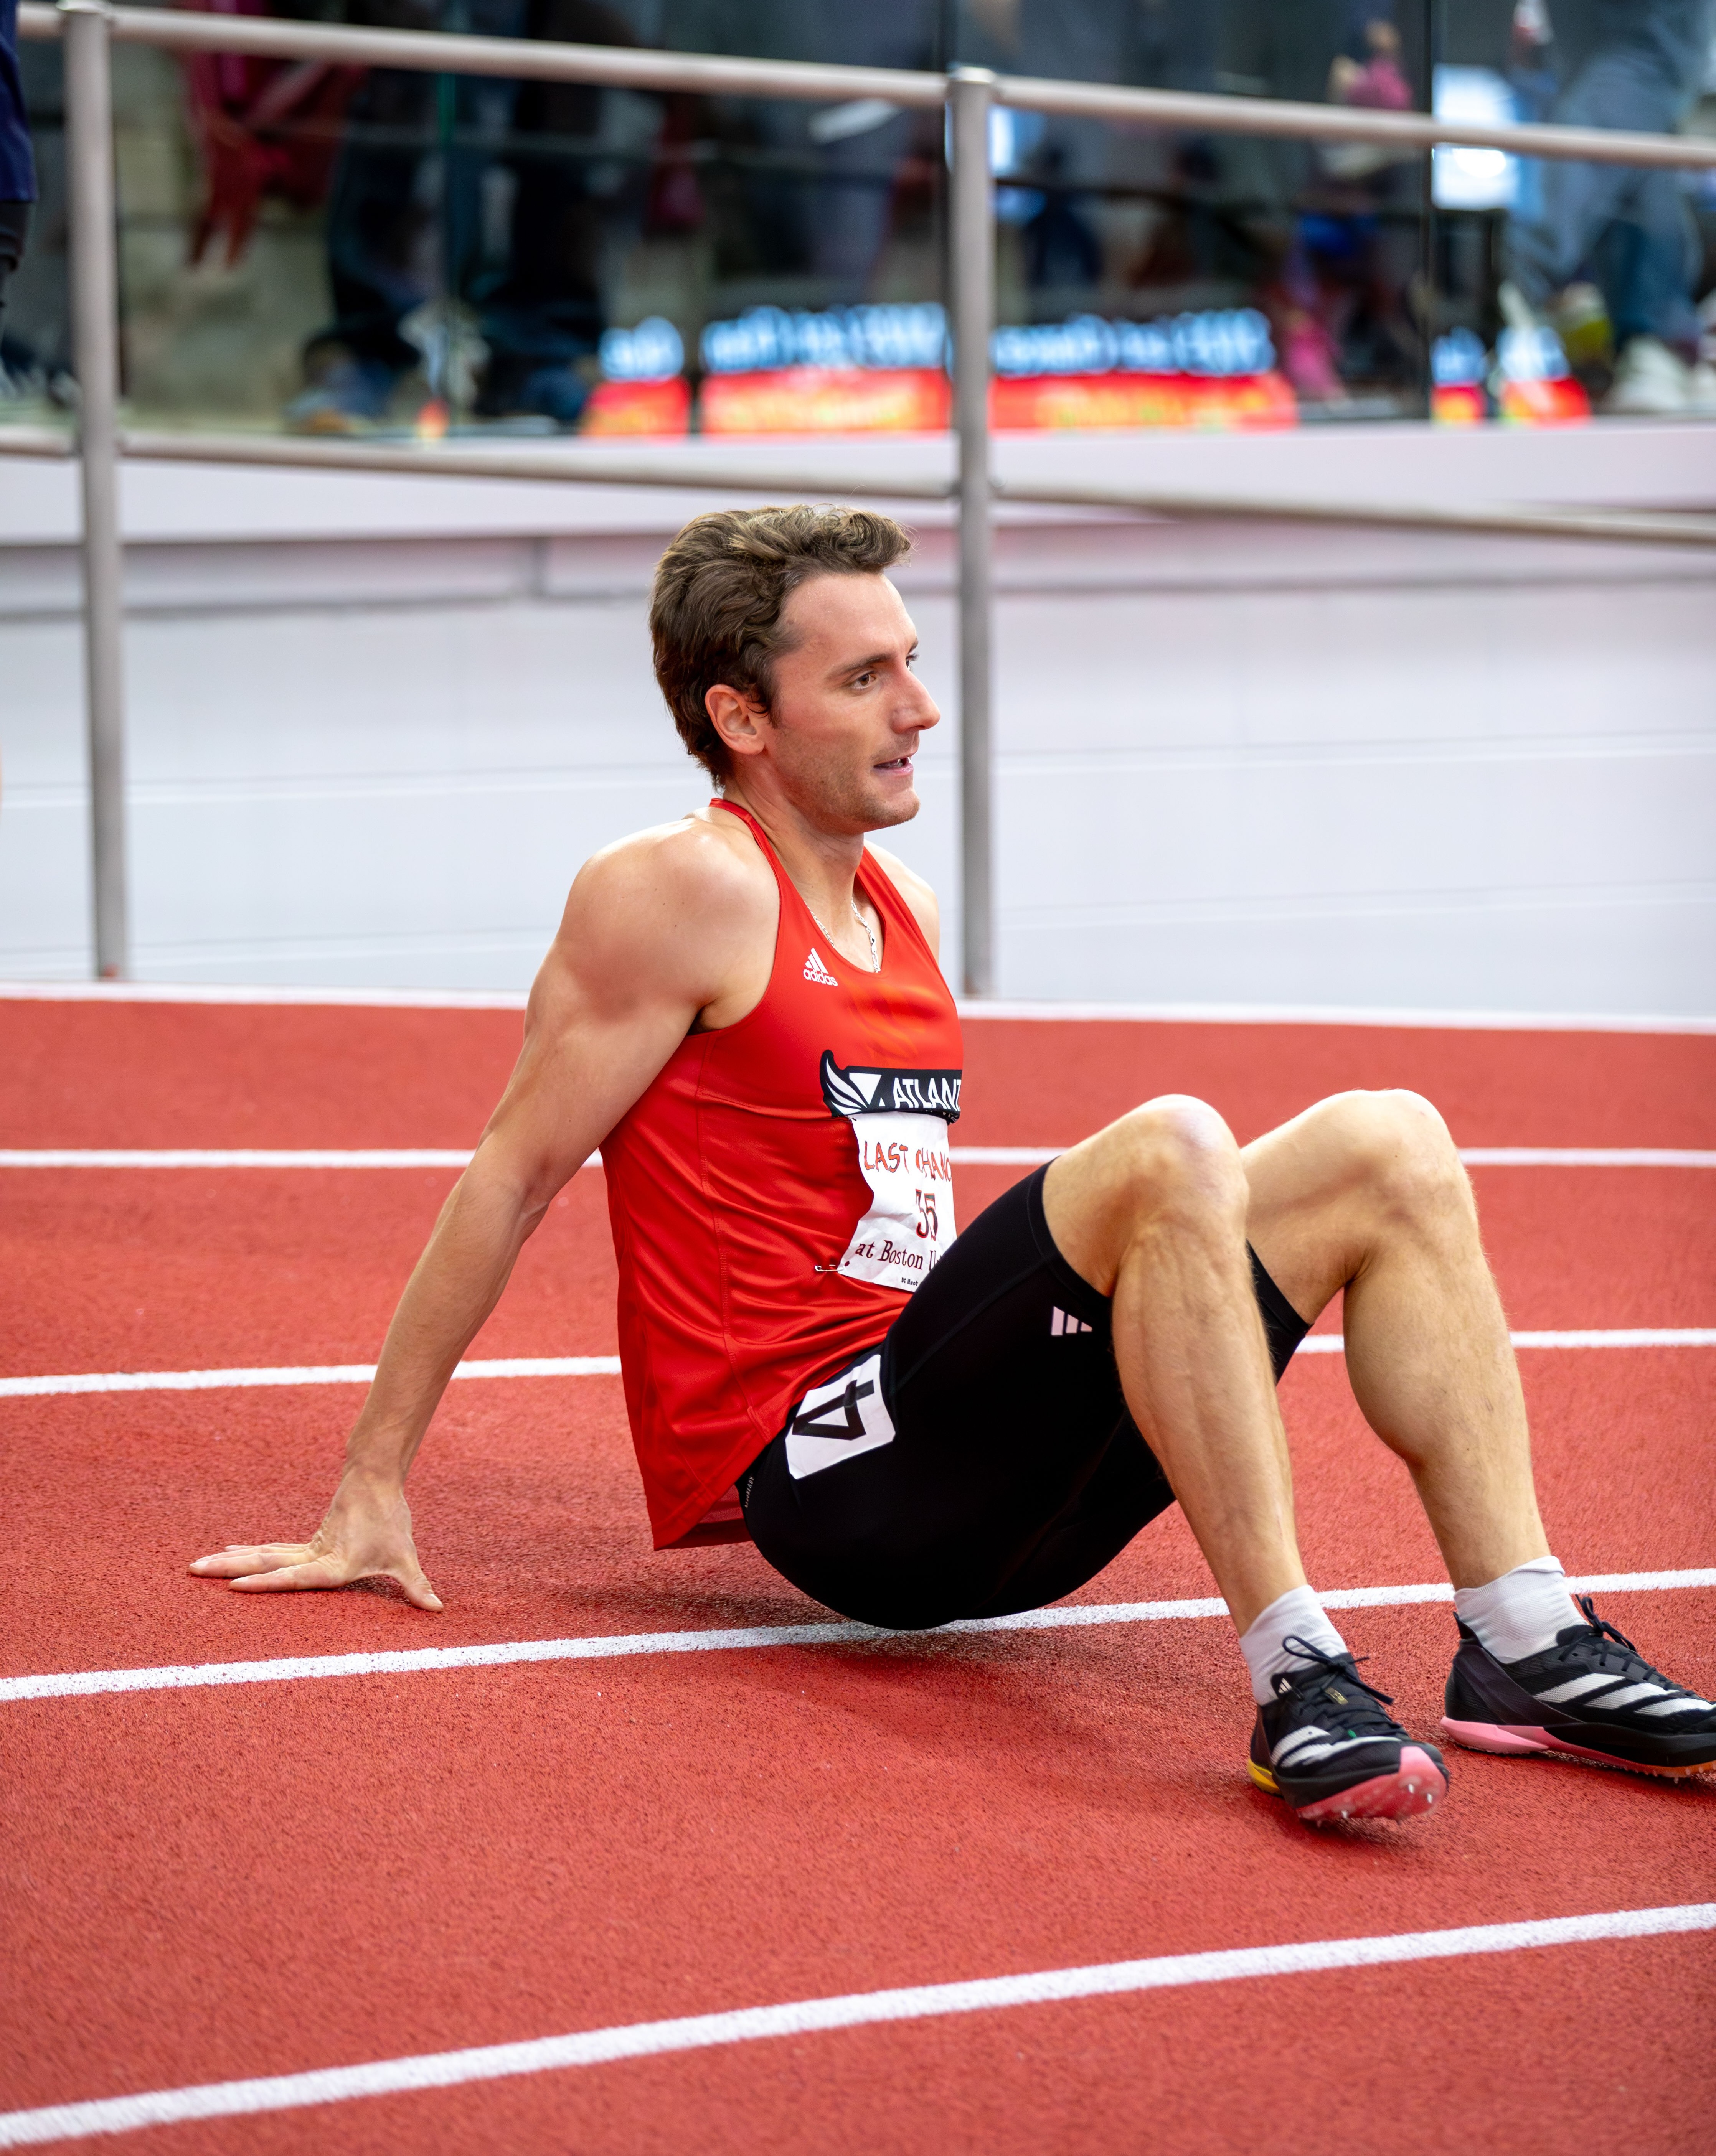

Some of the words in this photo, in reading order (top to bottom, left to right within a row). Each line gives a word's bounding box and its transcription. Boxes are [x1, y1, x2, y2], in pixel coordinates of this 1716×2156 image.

[803, 968, 838, 986] adidas
[864, 1140, 909, 1175] LAST
[915, 1189, 938, 1241] 35
[855, 1241, 875, 1258] at
[877, 1239, 923, 1270] Boston
[792, 1379, 874, 1441] 4
